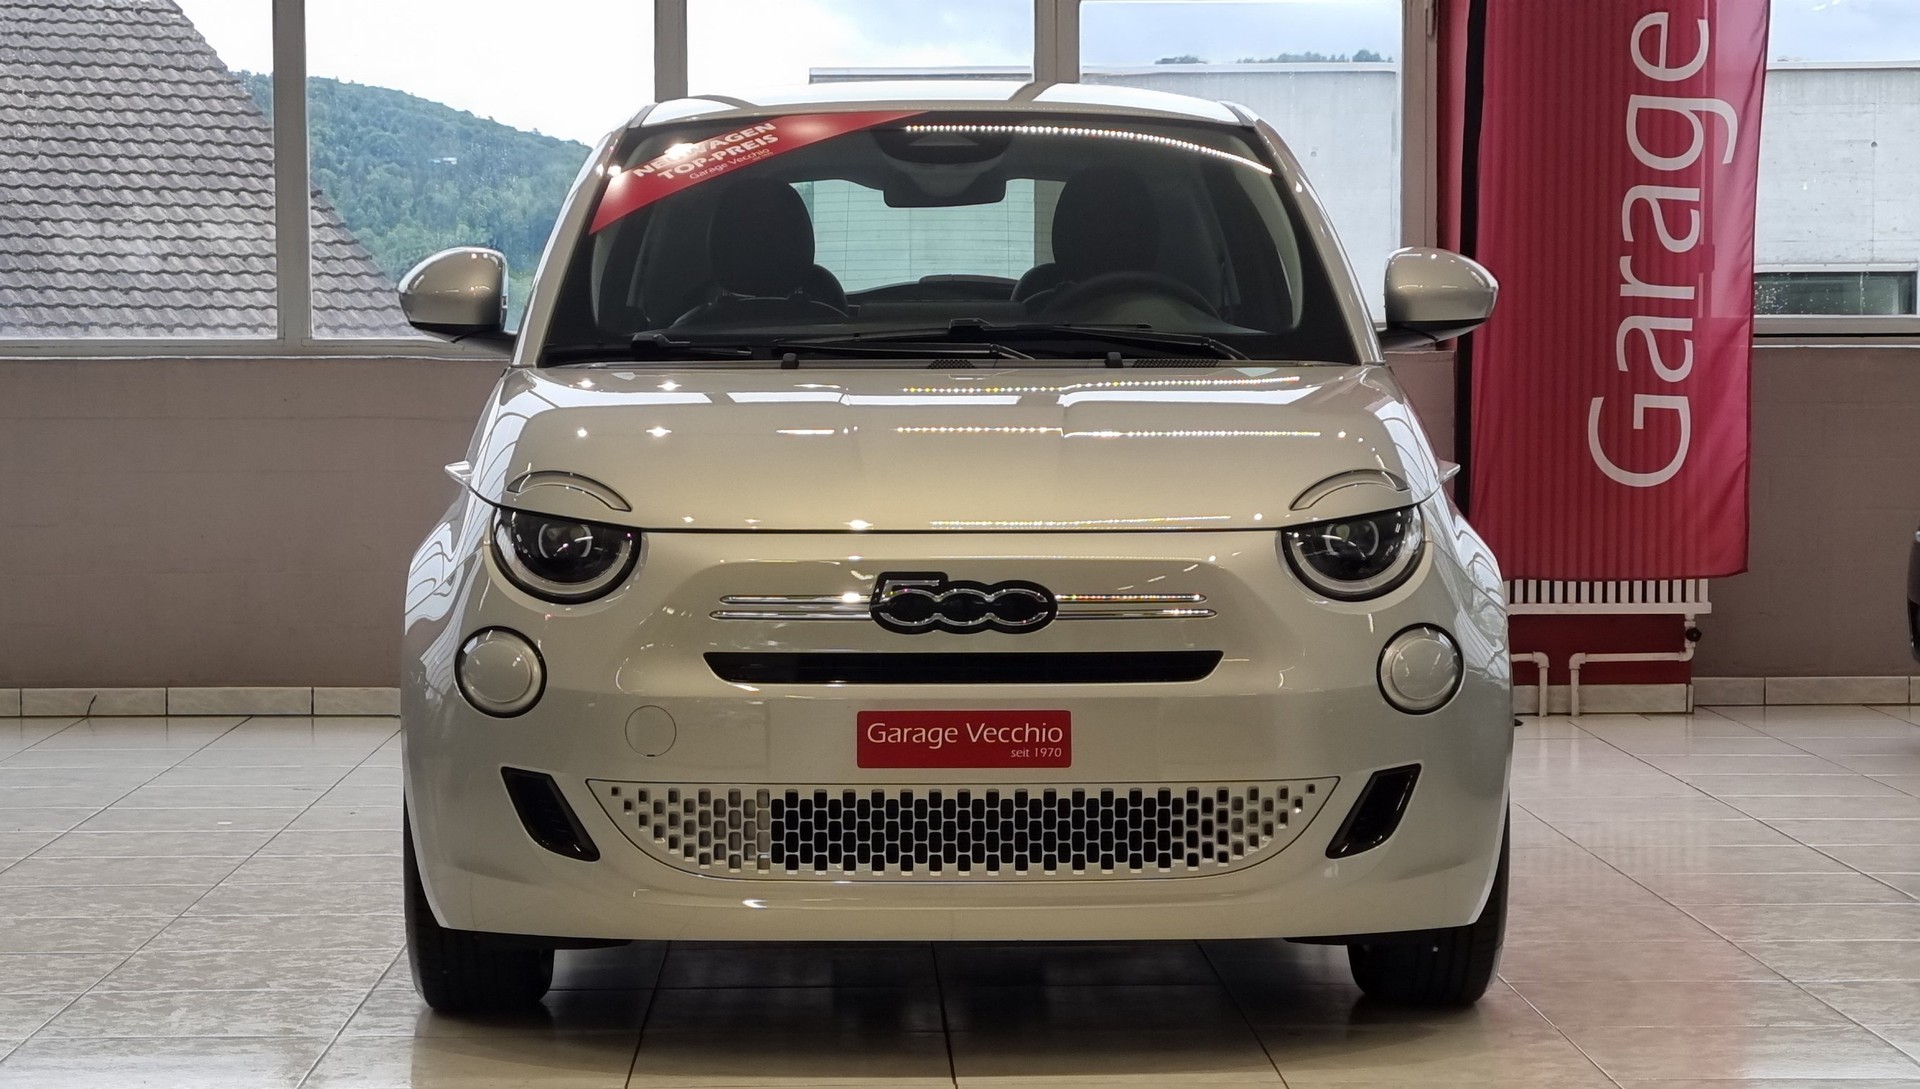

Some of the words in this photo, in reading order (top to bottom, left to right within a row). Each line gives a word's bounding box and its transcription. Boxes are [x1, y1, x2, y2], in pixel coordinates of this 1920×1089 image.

[632, 122, 777, 177] NEWAGEN
[657, 134, 778, 179] TOP-PREIS
[689, 162, 728, 180] Garage
[728, 148, 770, 165] Vecchio
[1588, 11, 1738, 488] Garage
[872, 574, 1055, 632] 500
[867, 722, 959, 750] Garage
[965, 722, 1063, 743] Vecchio
[1010, 747, 1030, 758] seit
[1034, 747, 1062, 758] 1970
